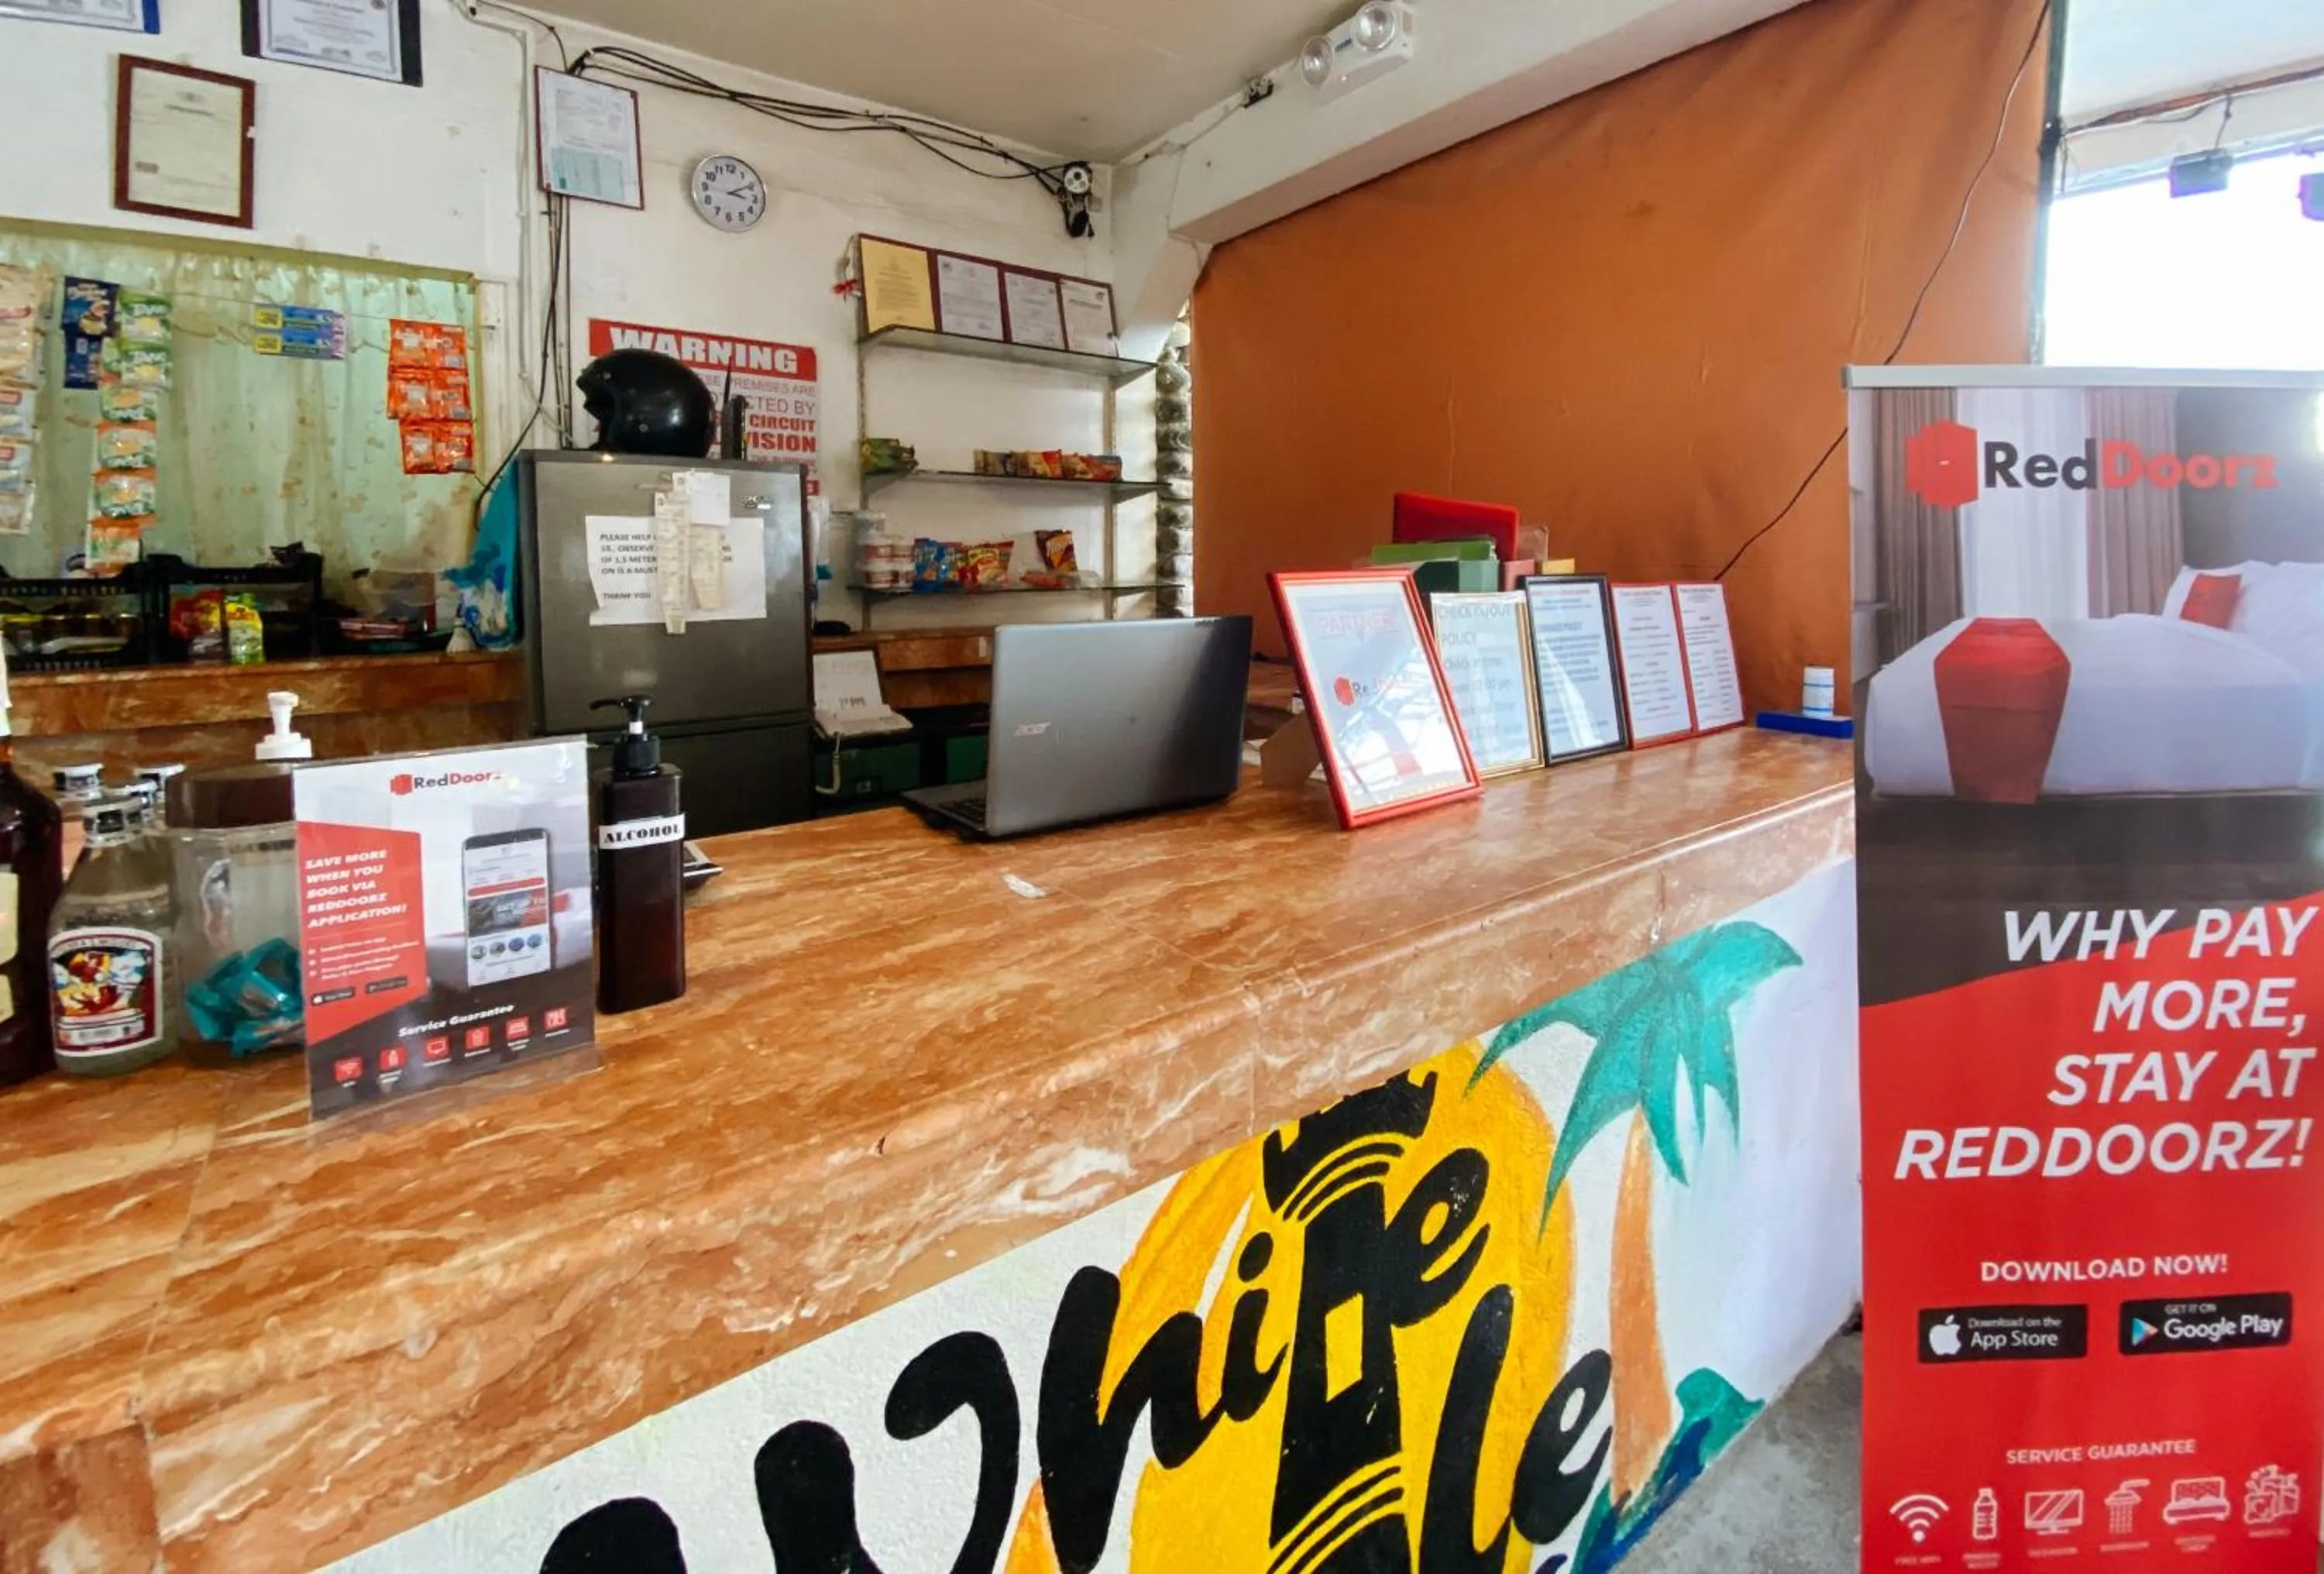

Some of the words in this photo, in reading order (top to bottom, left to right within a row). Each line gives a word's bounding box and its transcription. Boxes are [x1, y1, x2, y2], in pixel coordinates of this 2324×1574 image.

[705, 171, 717, 183] 10
[715, 165, 724, 174] 11
[725, 163, 737, 174] 12
[741, 171, 745, 180] 1
[701, 181, 709, 192] 9
[704, 194, 712, 205] 8
[751, 194, 758, 204] 3
[713, 206, 721, 216] 7
[725, 211, 733, 223] 6
[737, 211, 744, 222] 5
[747, 204, 755, 215] 4
[610, 327, 798, 375] WARNING
[794, 400, 816, 415] BY
[749, 414, 816, 432] CIRCUIT
[1984, 438, 2279, 490] RedDoorz
[1013, 721, 1051, 737] acer
[603, 823, 681, 844] ALCOHOL
[305, 856, 342, 870] SAVE
[345, 850, 387, 864] MORE
[306, 869, 350, 884] WHEN
[353, 864, 384, 877] YOU
[306, 884, 349, 899] BOOK
[352, 880, 376, 892] VIA
[308, 892, 387, 913] REDDOORZ
[307, 903, 407, 929] APPLICATION!
[2004, 909, 2176, 962] WHY
[2188, 906, 2319, 959] PAY
[2093, 978, 2307, 1037] MORE,
[397, 1019, 448, 1038] Service
[449, 1004, 516, 1026] Guarantee
[2047, 1050, 2219, 1106] STAY
[2226, 1047, 2318, 1100] AT
[1893, 1118, 2314, 1180] REDDOORZ!
[1980, 1260, 2146, 1284] DOWNLOAD
[2154, 1253, 2229, 1277] NOW!
[2164, 1304, 2184, 1315] GET
[2185, 1304, 2198, 1315] IT
[2199, 1303, 2216, 1314] ON
[1968, 1316, 2023, 1328] Download
[2025, 1318, 2041, 1328] on
[2043, 1317, 2062, 1328] the
[2164, 1318, 2236, 1342] Google
[2240, 1315, 2284, 1337] Play
[1970, 1331, 2007, 1350] App
[2011, 1330, 2059, 1347] Store
[2006, 1446, 2082, 1466] SERVICE
[2088, 1439, 2197, 1461] GUARANTEE
